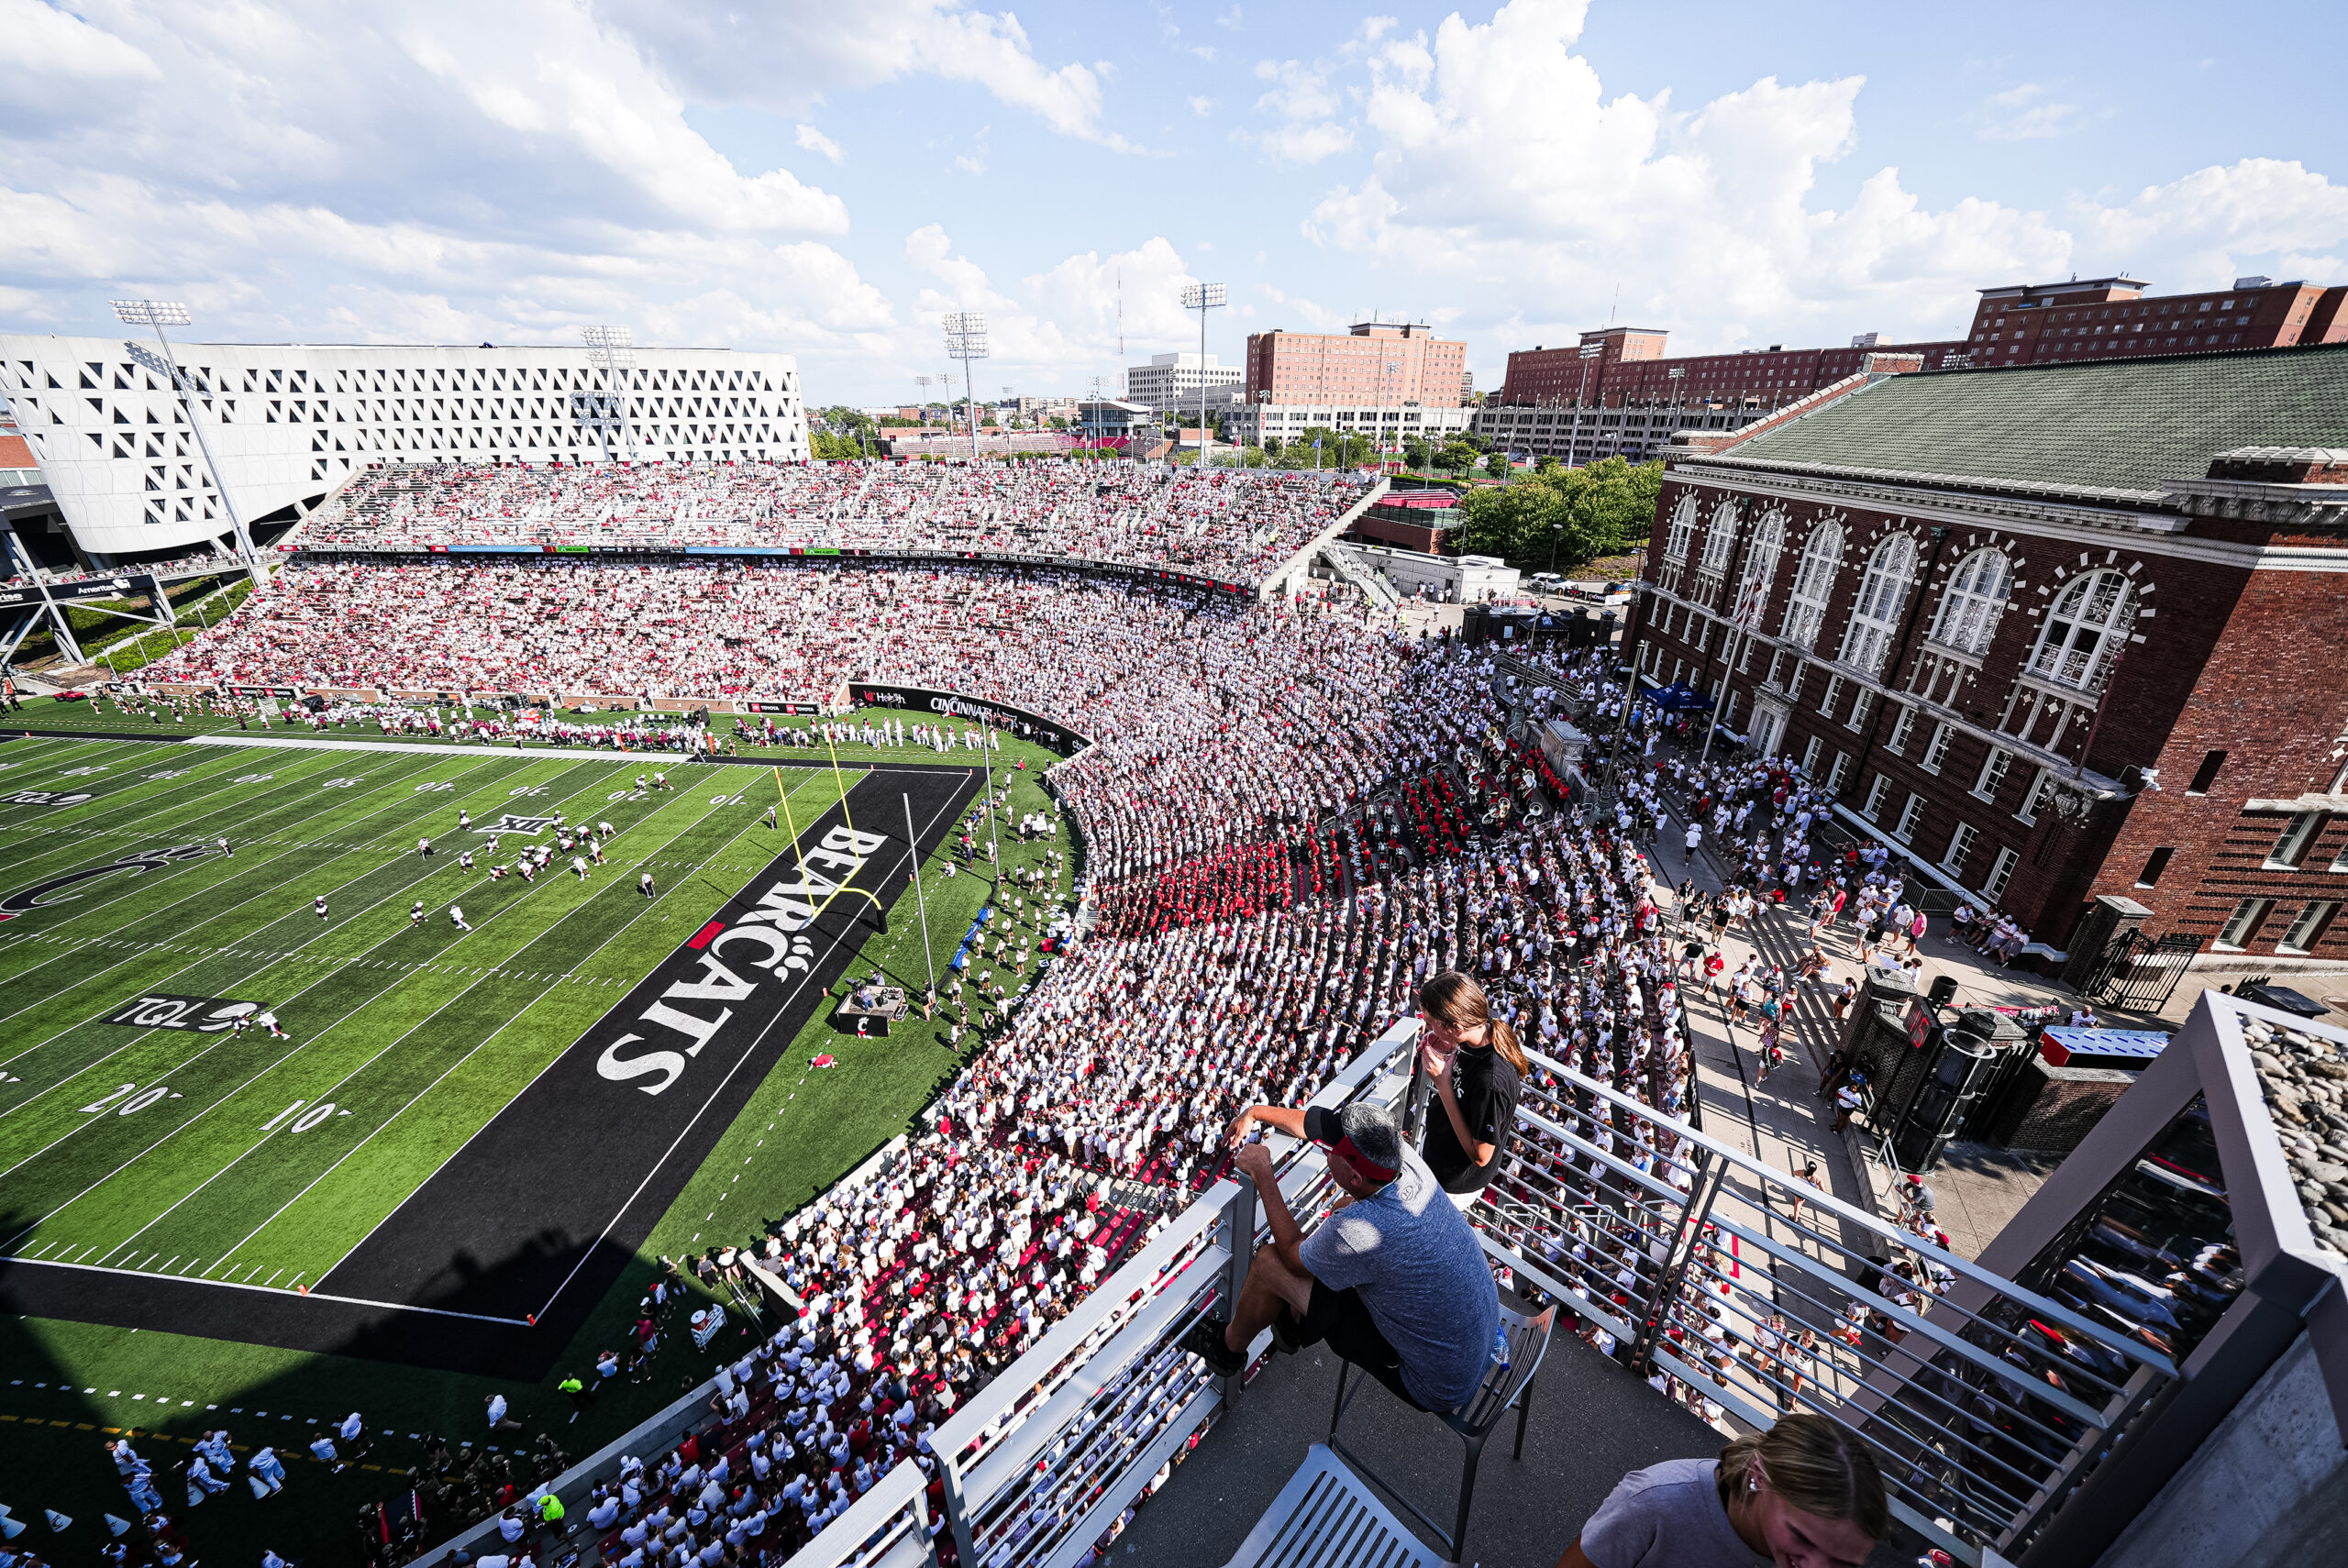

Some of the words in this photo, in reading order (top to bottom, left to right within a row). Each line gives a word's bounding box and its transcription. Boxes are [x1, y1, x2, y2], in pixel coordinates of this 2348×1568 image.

[1019, 555, 1046, 563] BEARCATS
[1052, 558, 1080, 566] DEDICATED
[1102, 564, 1135, 574] MEDPACE
[78, 585, 117, 594] Ameritas
[322, 778, 364, 788] 50
[414, 781, 454, 792] 40
[508, 786, 550, 796] 30
[606, 790, 649, 801] 20
[1, 790, 62, 804] TQL
[709, 795, 745, 806] 10
[596, 823, 888, 1096] BEARCATS
[113, 997, 205, 1028] TQL
[1910, 1010, 1930, 1049] 15
[77, 1083, 170, 1116] 20
[257, 1099, 337, 1133] 10
